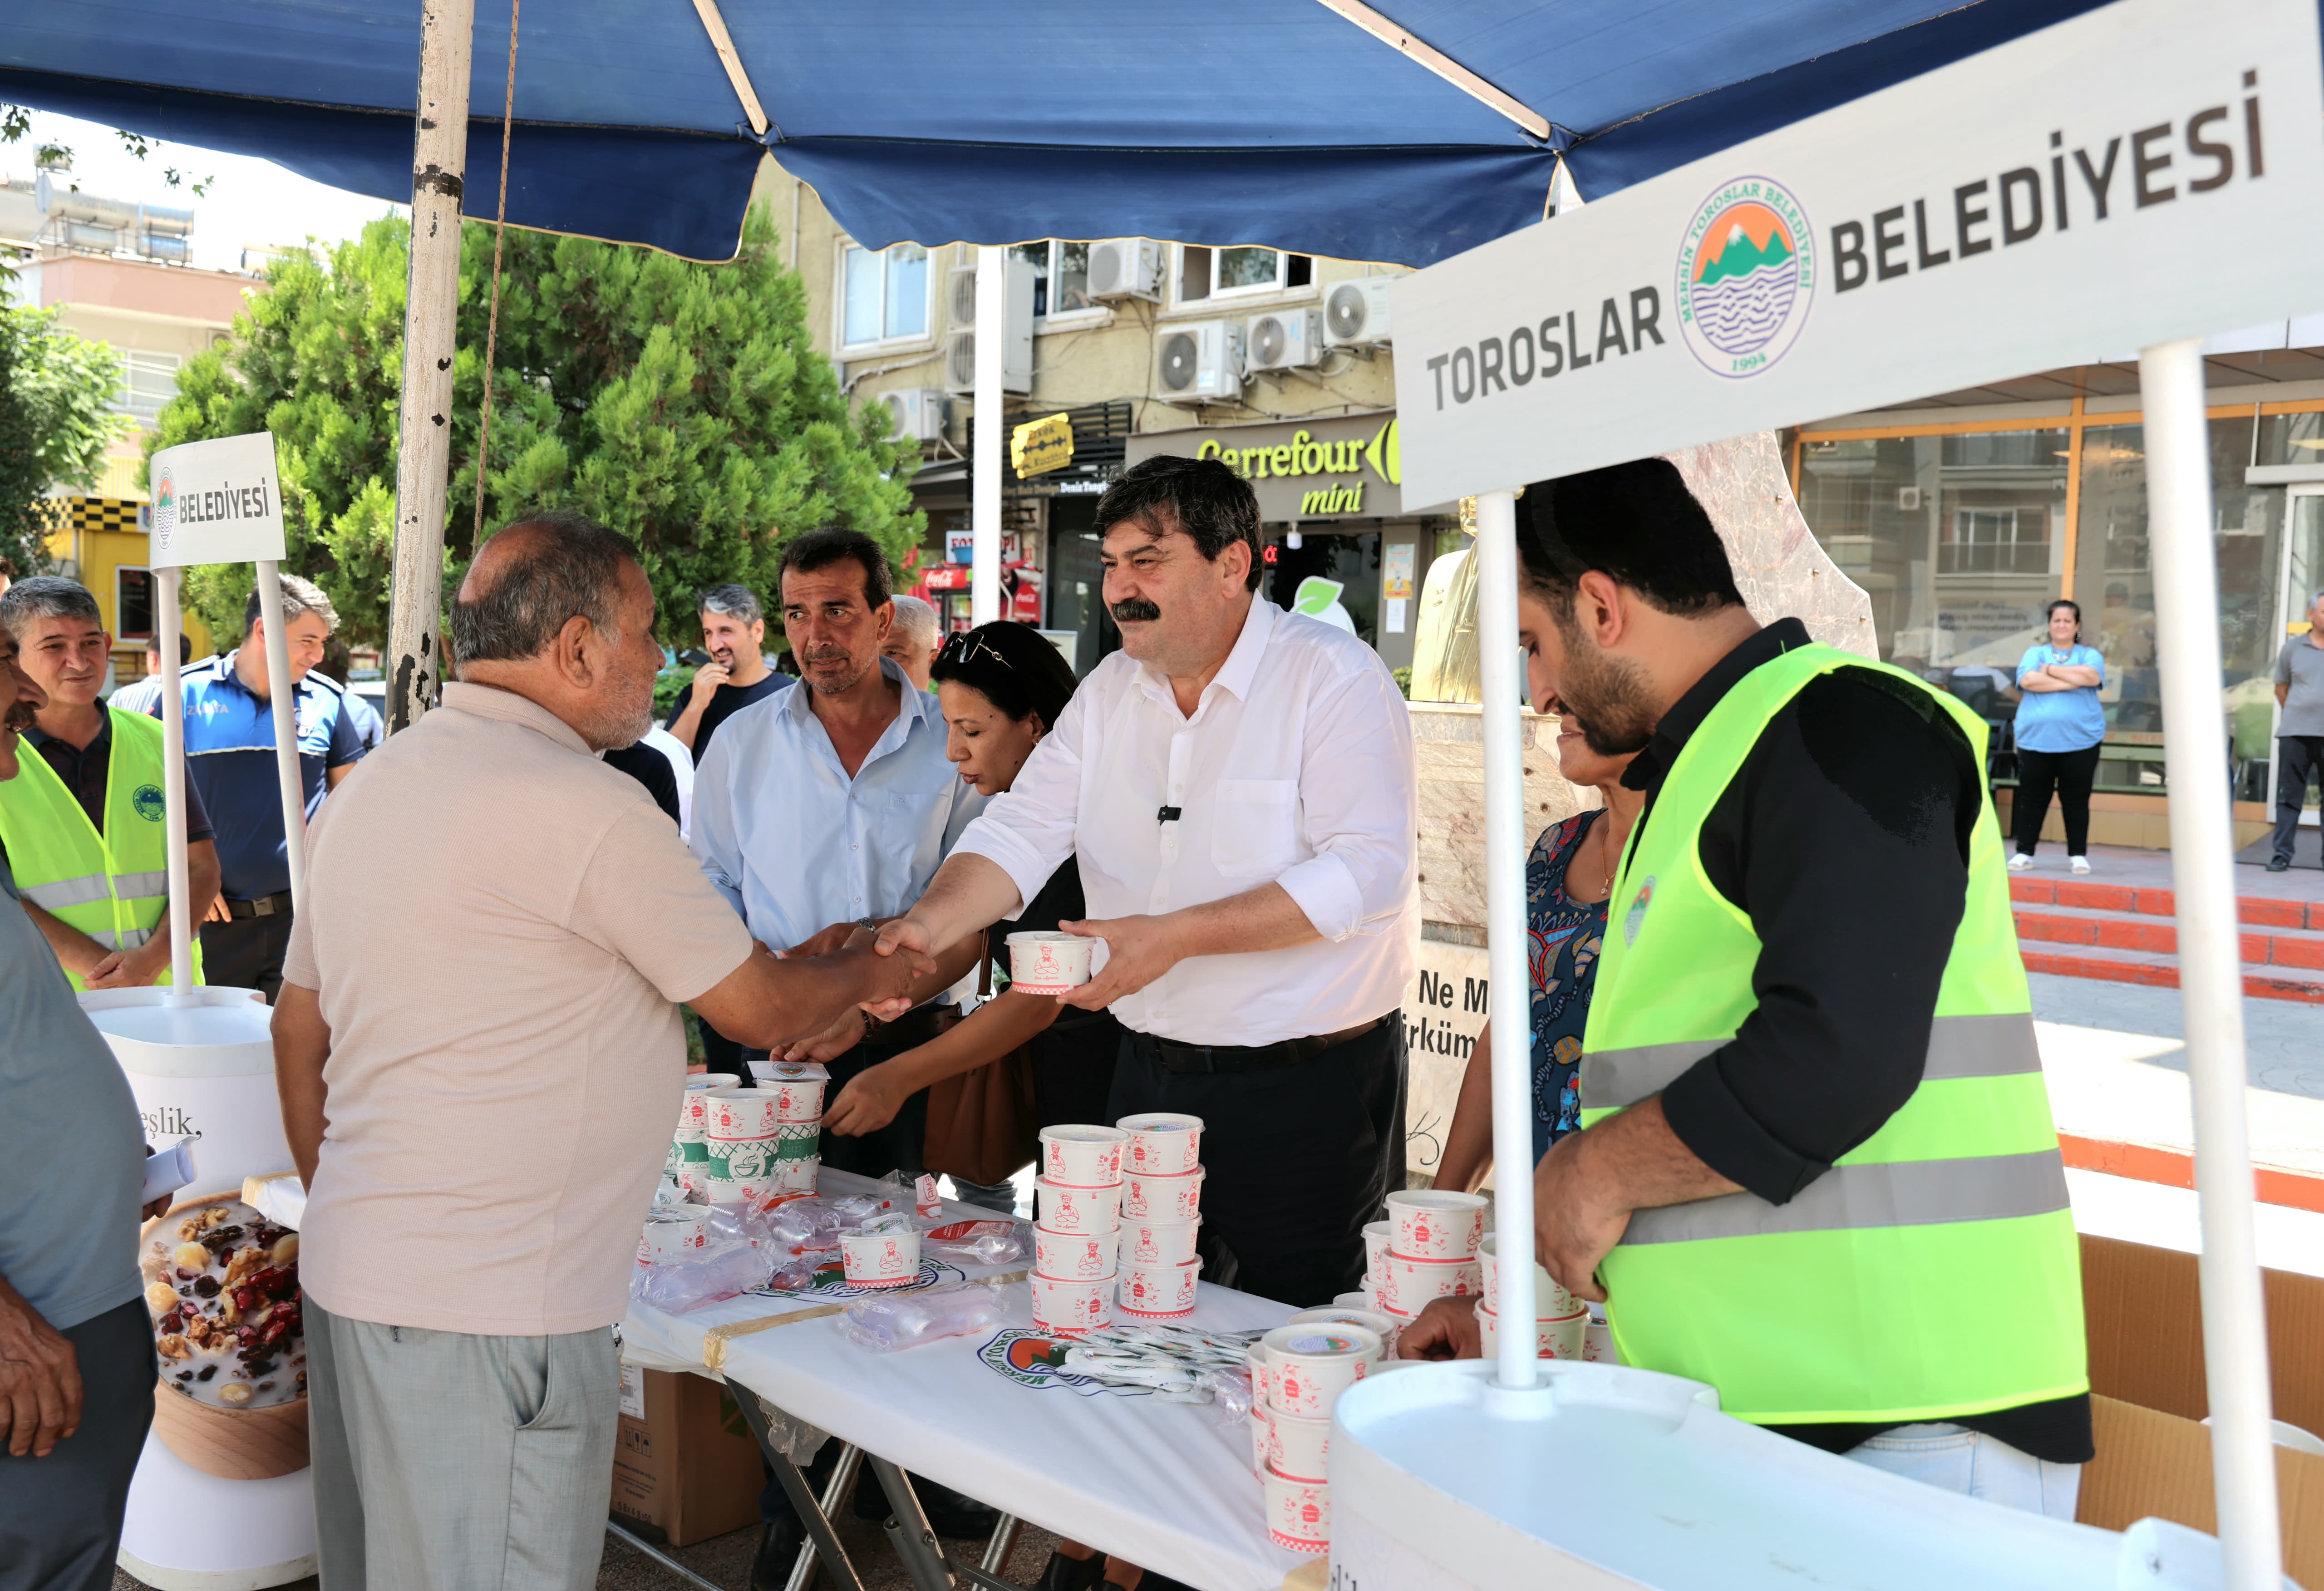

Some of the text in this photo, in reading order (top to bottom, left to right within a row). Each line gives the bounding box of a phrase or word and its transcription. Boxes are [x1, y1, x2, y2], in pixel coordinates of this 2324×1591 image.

[1428, 68, 2265, 412] TOROSLAR BELEDİYESİ
[1679, 183, 1812, 324] MERSİN TOROSLAR BELEDİYESİ
[1731, 352, 1768, 372] 1994
[1197, 430, 1365, 479] Carrefour
[179, 477, 269, 524] BELEDİYESİ
[1300, 480, 1363, 514] mini
[1419, 970, 1453, 1008] Ne
[140, 1107, 202, 1141] eşlik,
